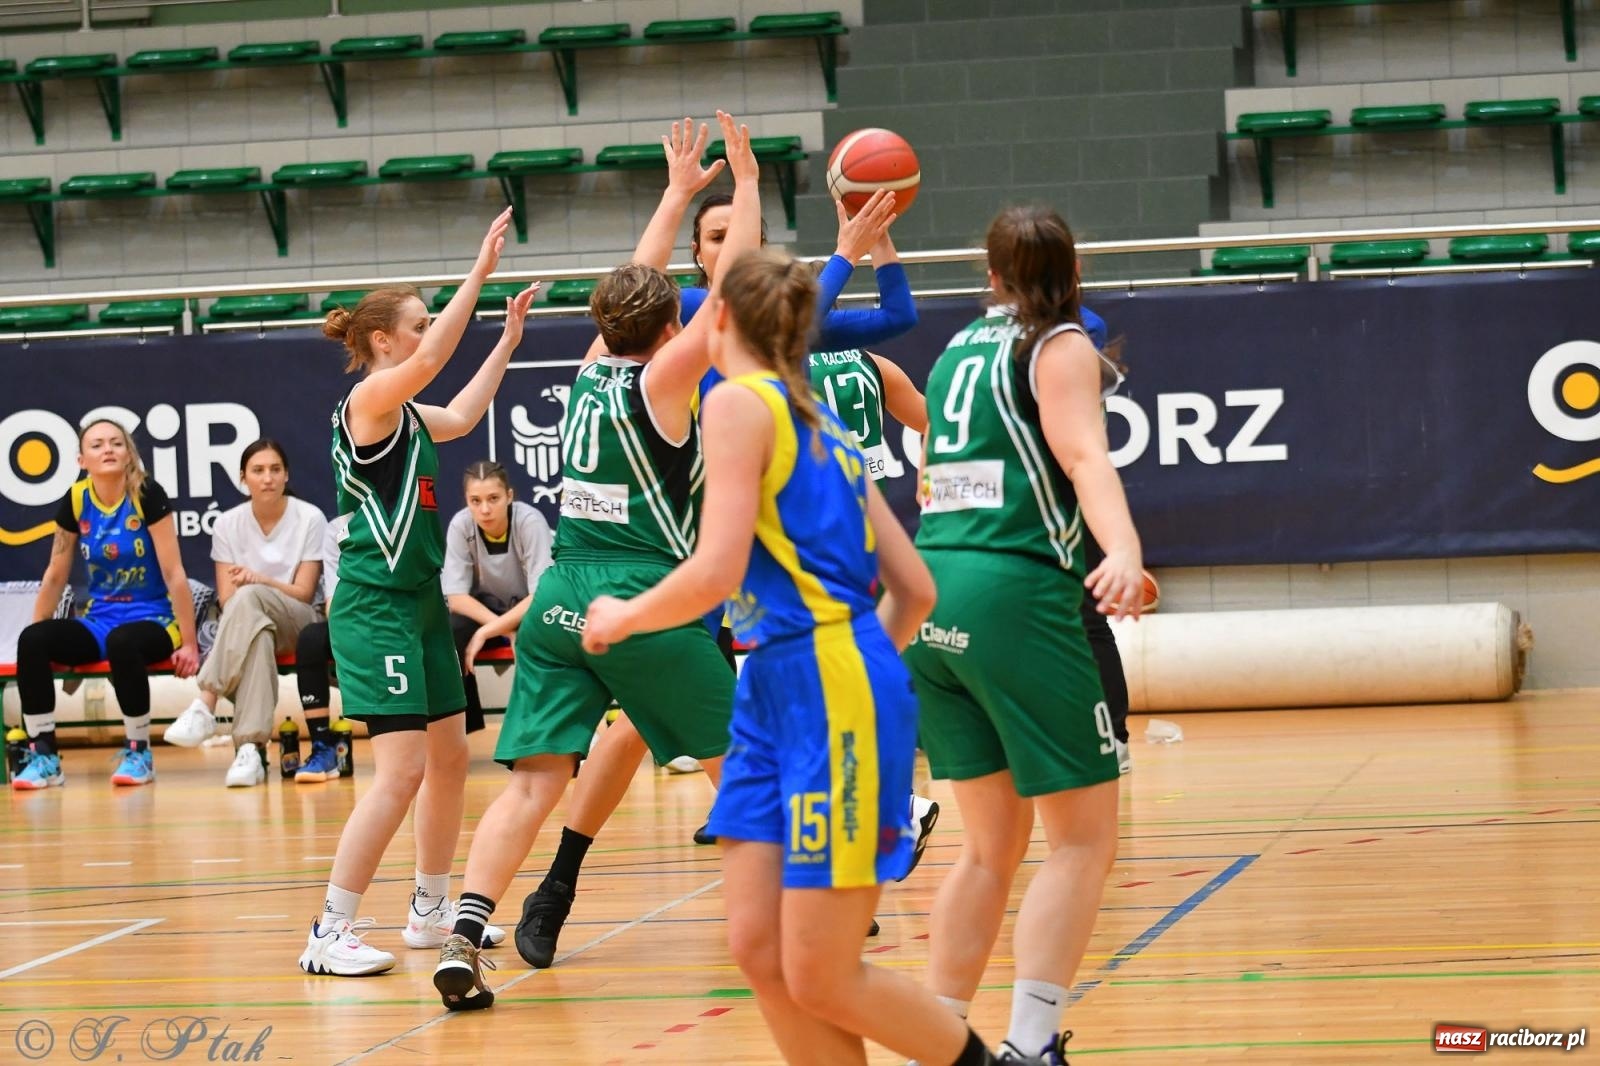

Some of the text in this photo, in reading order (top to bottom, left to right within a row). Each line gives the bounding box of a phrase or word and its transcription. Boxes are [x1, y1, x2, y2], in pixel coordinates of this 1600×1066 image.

[823, 371, 870, 443] 13
[934, 355, 985, 454] 9
[134, 537, 145, 557] 8
[920, 621, 970, 649] Clavis
[384, 655, 409, 695] 5
[1093, 701, 1116, 755] 9
[789, 792, 828, 852] 15
